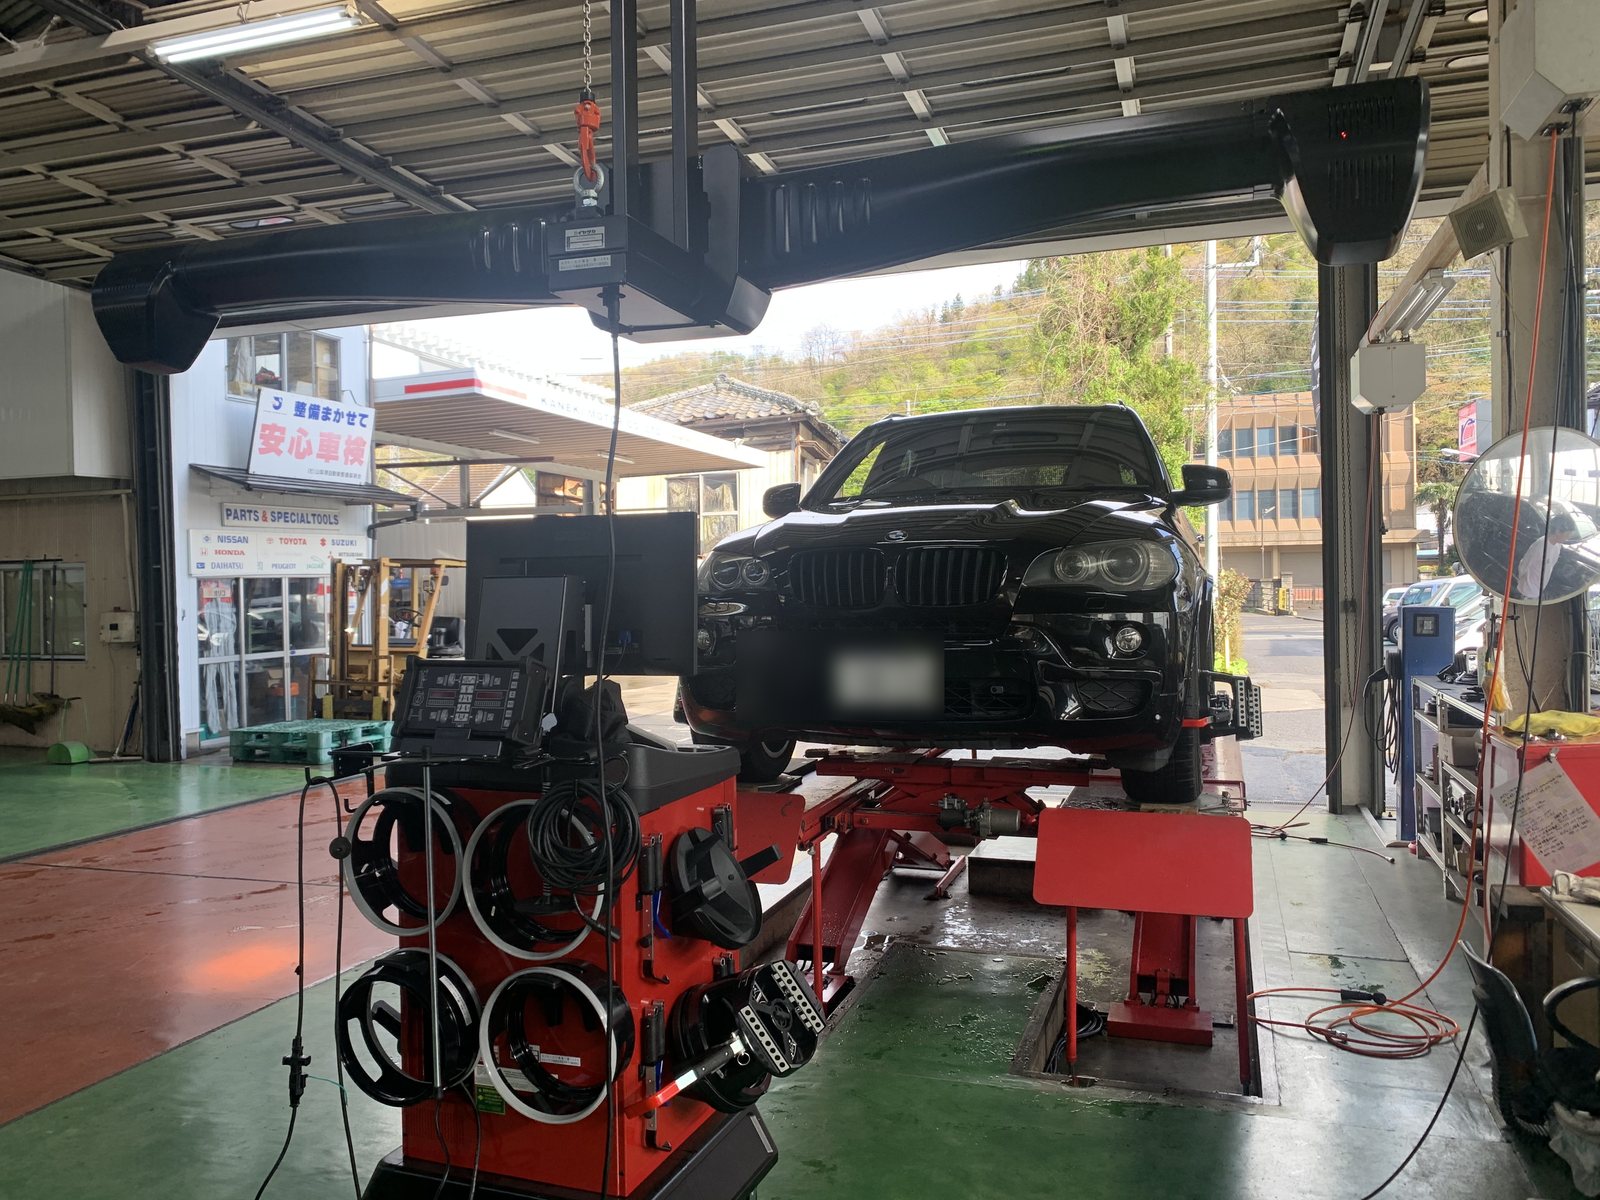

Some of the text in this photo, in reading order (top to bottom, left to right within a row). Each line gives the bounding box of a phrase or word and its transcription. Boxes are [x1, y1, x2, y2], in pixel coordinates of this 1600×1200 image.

[293, 400, 369, 428] 整備まかせて
[258, 423, 367, 466] 安心車検
[225, 507, 260, 522] PARTS
[261, 510, 269, 523] &
[217, 535, 249, 544] NISSAN
[279, 537, 307, 546] TOYOTA
[331, 538, 357, 546] SUZUKI
[210, 562, 244, 570] DAIHATSU
